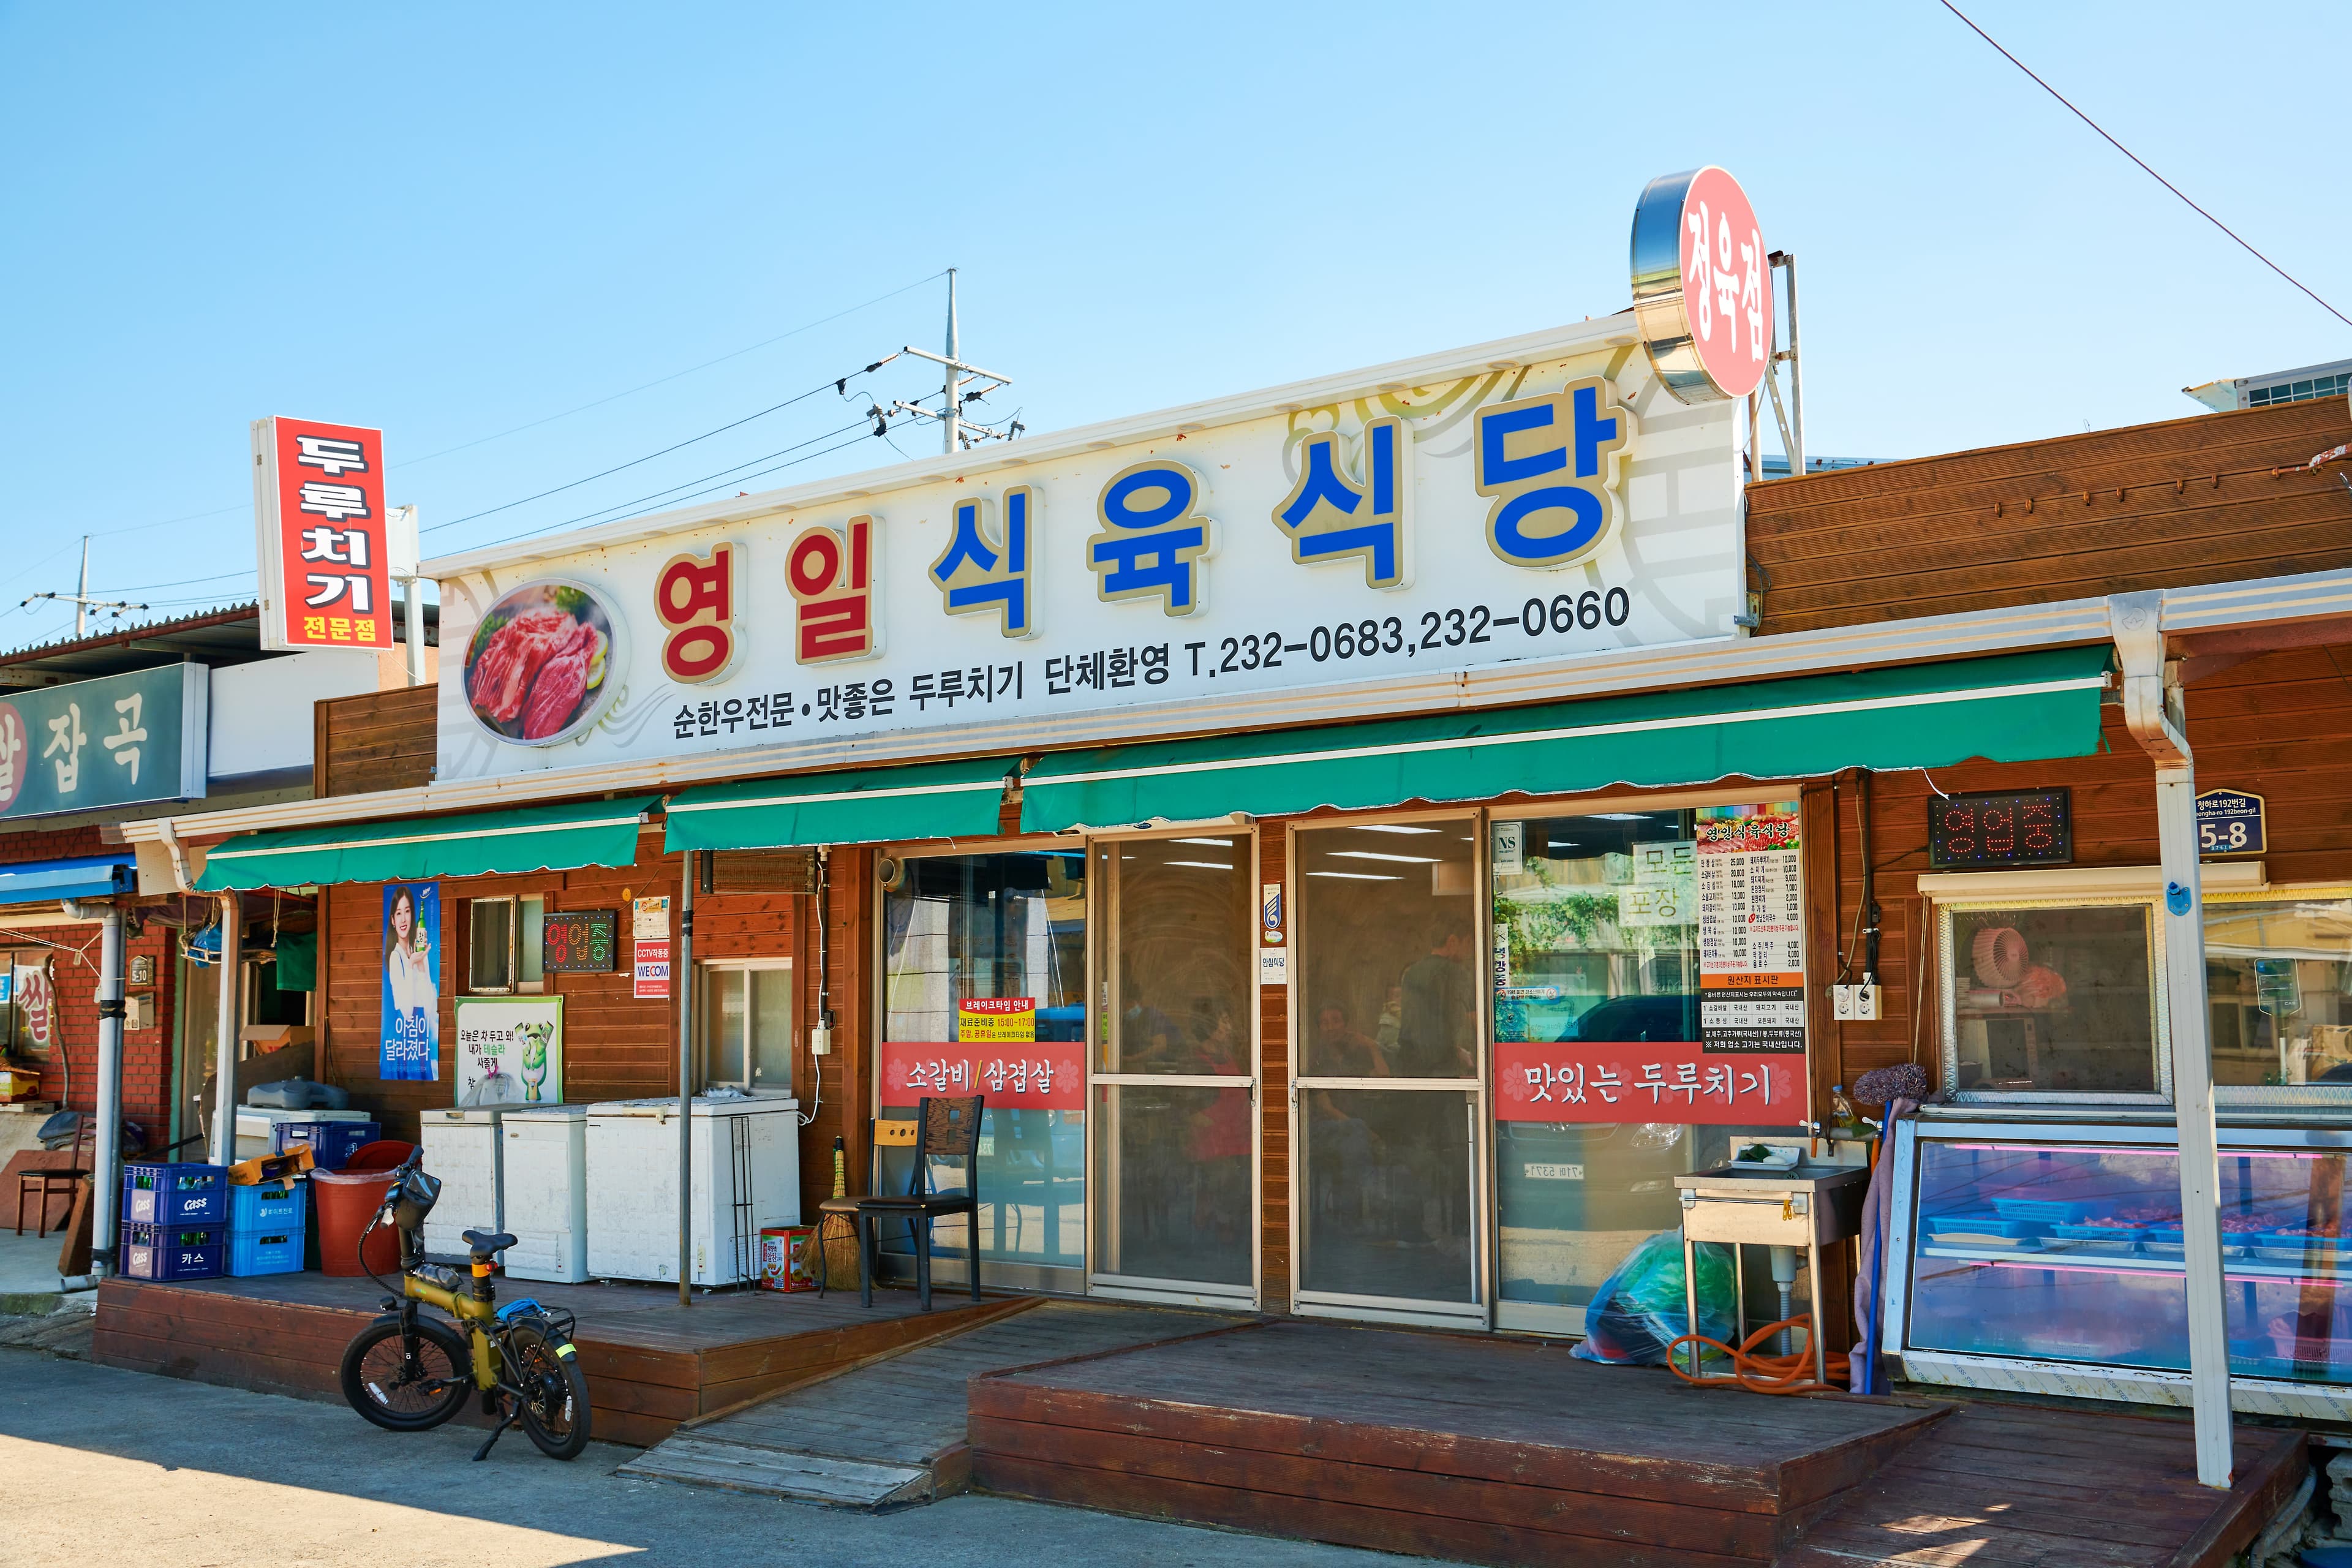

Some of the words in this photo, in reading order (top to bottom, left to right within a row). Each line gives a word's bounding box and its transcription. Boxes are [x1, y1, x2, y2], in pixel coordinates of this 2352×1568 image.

[1687, 200, 1763, 363] 정육점
[296, 434, 372, 612] 두루치기
[303, 616, 377, 642] 전문점
[908, 660, 1023, 712] 두루치기
[1045, 643, 1170, 695] 단체환영
[43, 692, 148, 794] 잡곡
[2197, 797, 2246, 810] 청하로192번길
[1706, 823, 1790, 842] 영일식육식당
[1944, 802, 2052, 854] 영업중
[2201, 821, 2247, 848] 5-8
[1499, 836, 1515, 850] NS
[1643, 846, 1695, 875] 모든
[1702, 870, 1716, 879] 소갈비살
[1627, 888, 1680, 918] 포장
[1752, 895, 1765, 903] 된장찌개
[1702, 903, 1716, 912] 돼지갈비
[1732, 914, 1746, 923] 10,000
[547, 922, 609, 964] 영업중
[637, 948, 669, 959] CCTV작동중
[1733, 949, 1746, 957] 10,000
[1262, 957, 1284, 967] 안심식당
[1788, 959, 1800, 968] 2,000
[132, 970, 147, 981] 5-10
[638, 965, 669, 977] WECOM
[1727, 975, 1751, 986] 원산지
[1754, 975, 1779, 985] 표시판
[965, 1000, 1011, 1011] 브레이크타임
[1013, 1000, 1028, 1011] 안내
[395, 1014, 429, 1038] 아침이
[960, 1018, 995, 1027] 재료준비중
[997, 1017, 1035, 1027] 15:00~17:00
[461, 1030, 479, 1042] 오늘은
[481, 1030, 488, 1042] 차
[489, 1030, 504, 1042] 두고
[385, 1038, 431, 1061] 달라졌다
[469, 1043, 482, 1055] 내가
[483, 1044, 505, 1056] 테슬라
[477, 1057, 498, 1069] 사줄게
[1524, 1062, 1623, 1104] 맛있는
[1634, 1062, 1771, 1105] 두루치기
[136, 1199, 150, 1213] Cass
[184, 1197, 207, 1211] Cass
[133, 1251, 148, 1265] Cass
[181, 1253, 204, 1264] 카스
